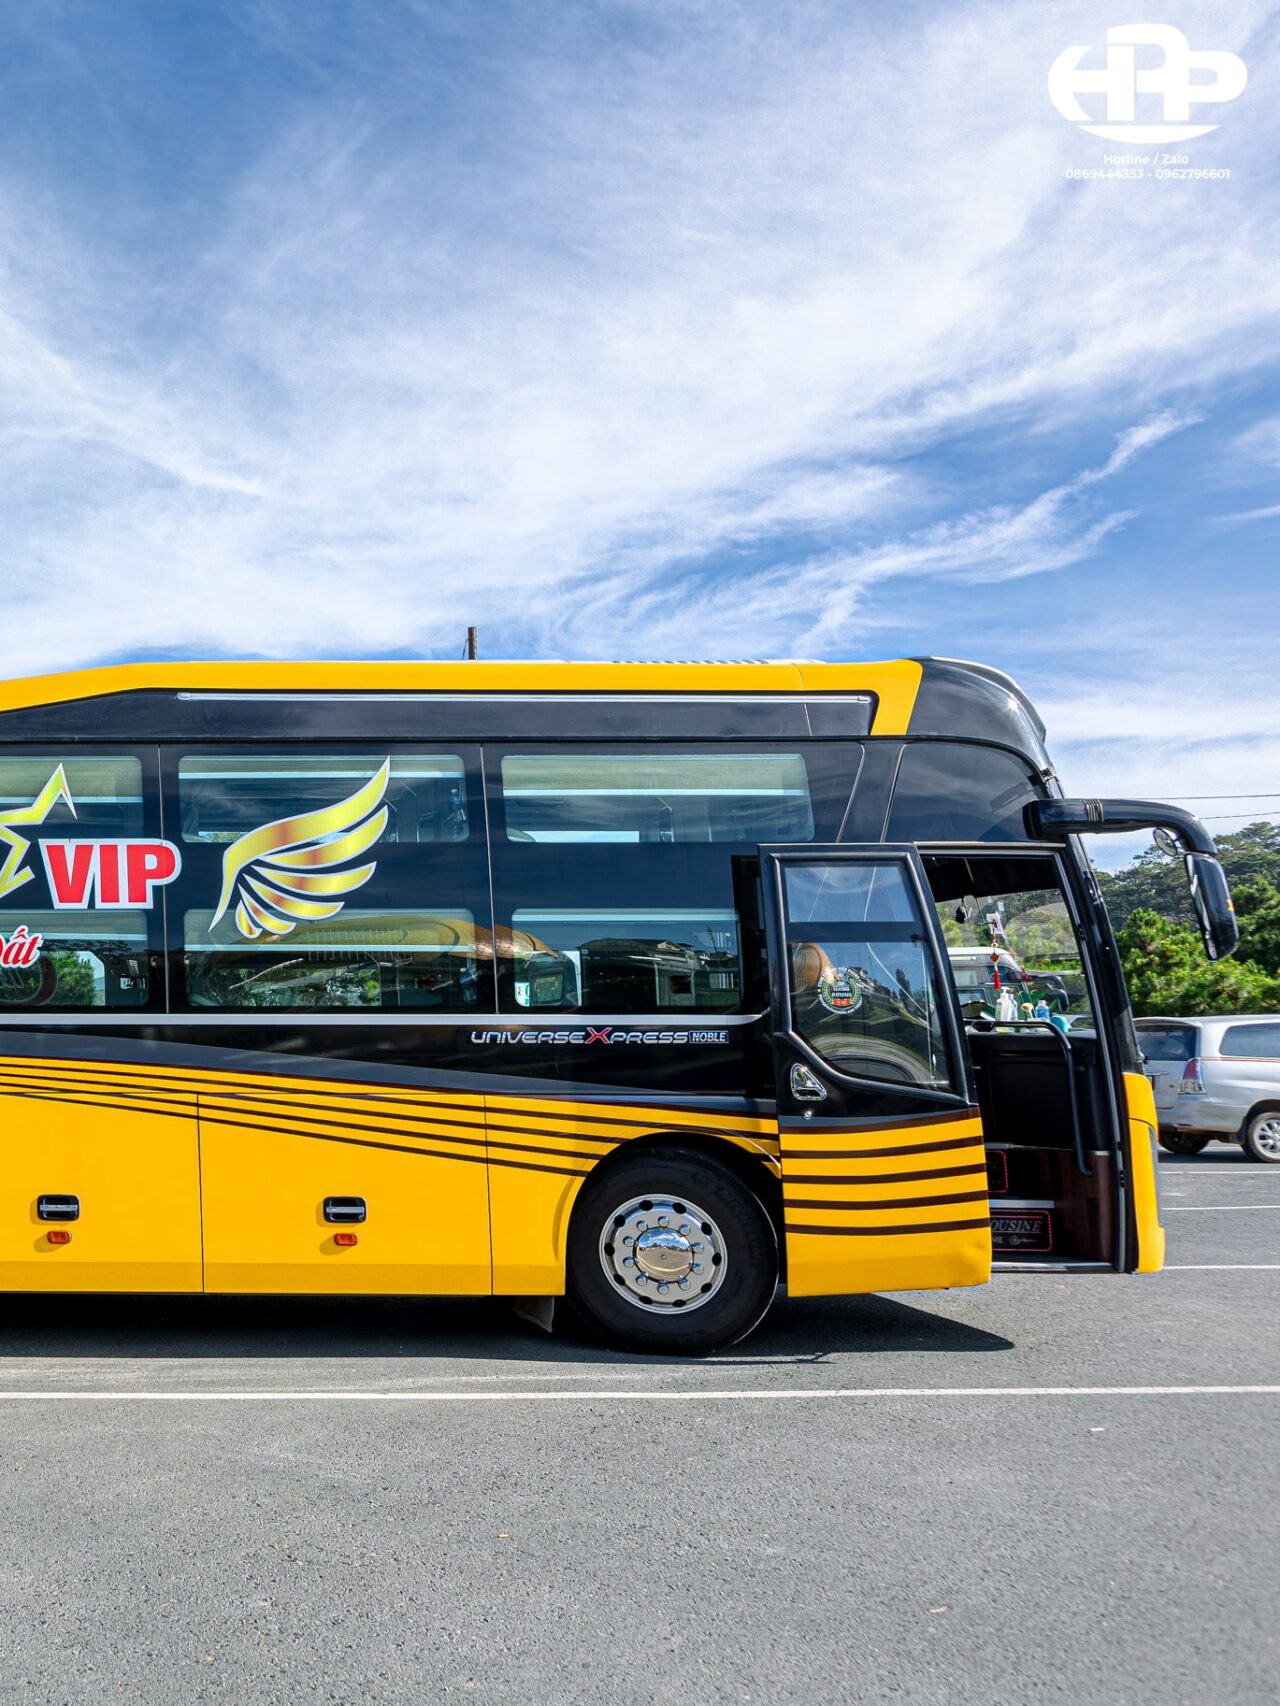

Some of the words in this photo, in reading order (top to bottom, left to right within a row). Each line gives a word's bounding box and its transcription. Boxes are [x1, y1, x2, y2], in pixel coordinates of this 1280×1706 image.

[38, 837, 182, 911] VIP
[689, 1031, 729, 1043] NOBLE
[991, 1220, 1041, 1232] OUSINE
